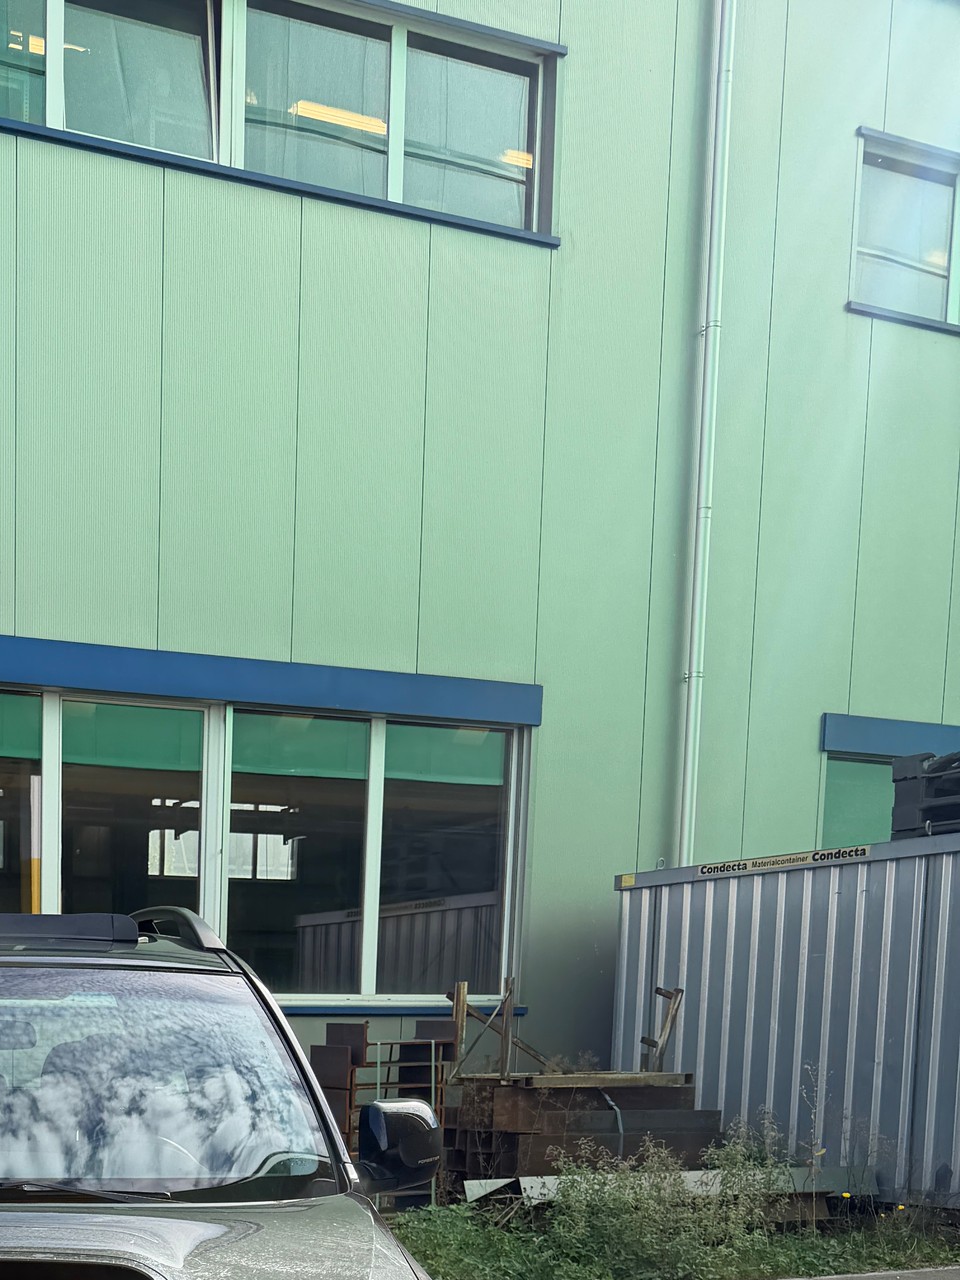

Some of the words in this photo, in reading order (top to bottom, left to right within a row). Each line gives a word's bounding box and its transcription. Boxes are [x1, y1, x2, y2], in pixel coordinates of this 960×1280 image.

[700, 862, 747, 875] Condecta
[751, 855, 808, 868] Materialcontainer
[812, 847, 867, 862] Condecta
